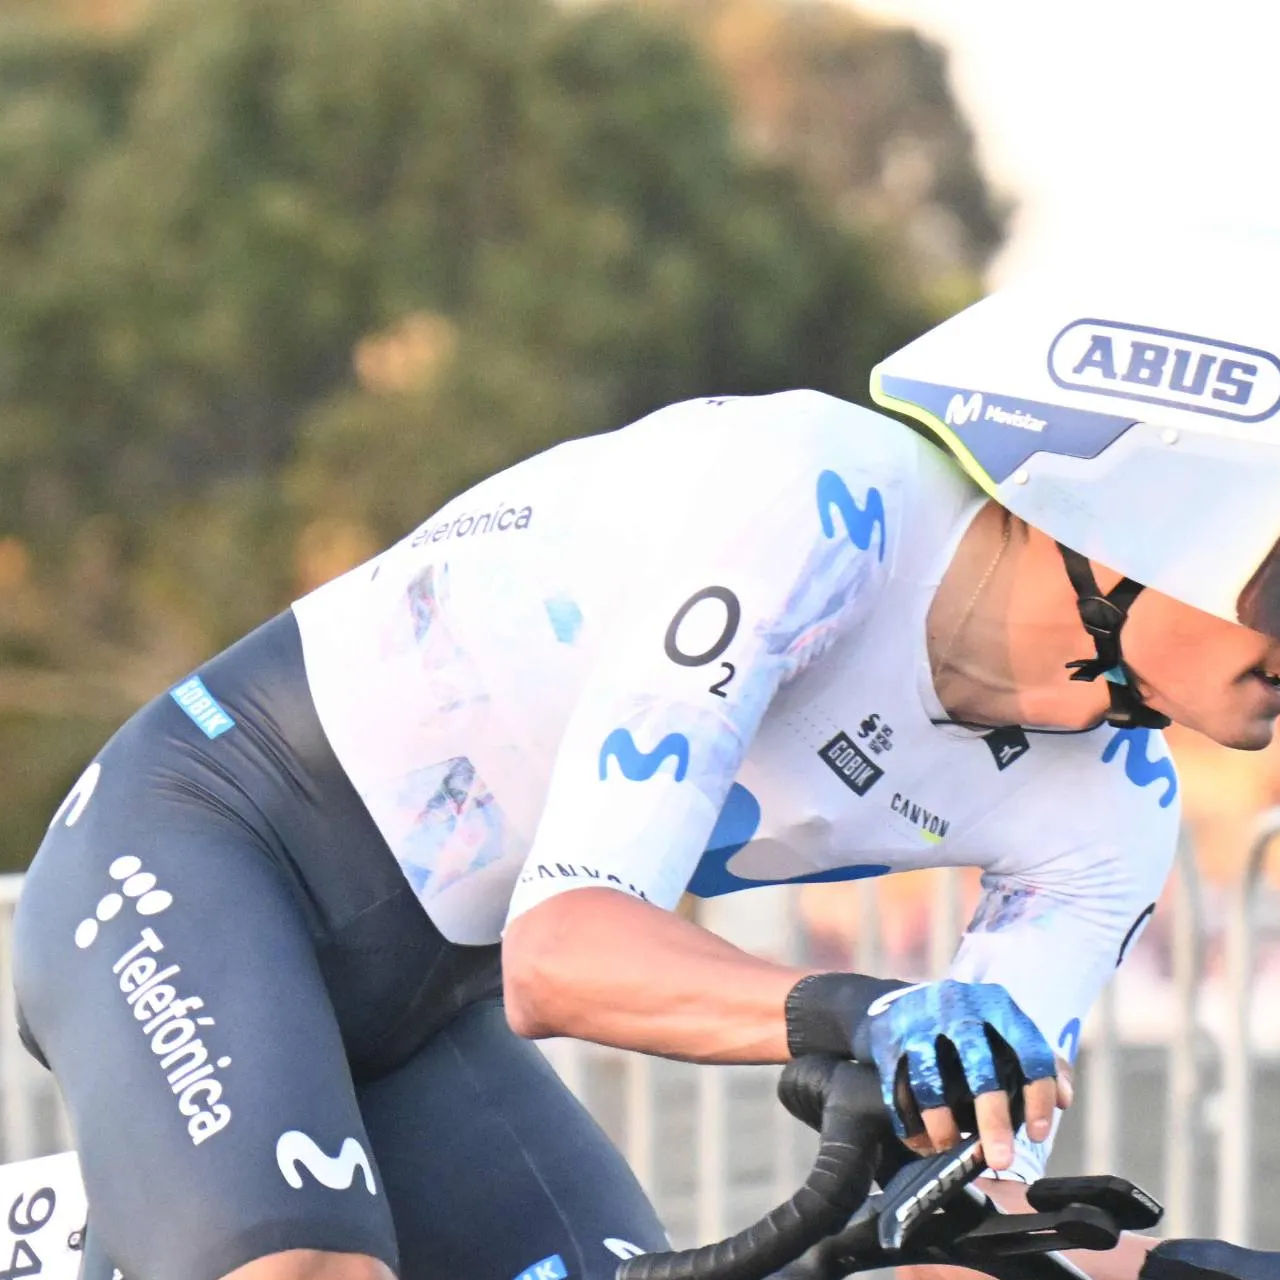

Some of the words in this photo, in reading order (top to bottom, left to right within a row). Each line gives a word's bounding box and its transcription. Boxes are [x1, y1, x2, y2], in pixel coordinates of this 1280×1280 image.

[1072, 334, 1258, 405] ABUS
[984, 404, 1049, 433] Movistar
[175, 680, 229, 735] GOBIK
[827, 739, 875, 788] GOBIK
[890, 792, 951, 838] CANYON
[112, 928, 232, 1146] Telefónica
